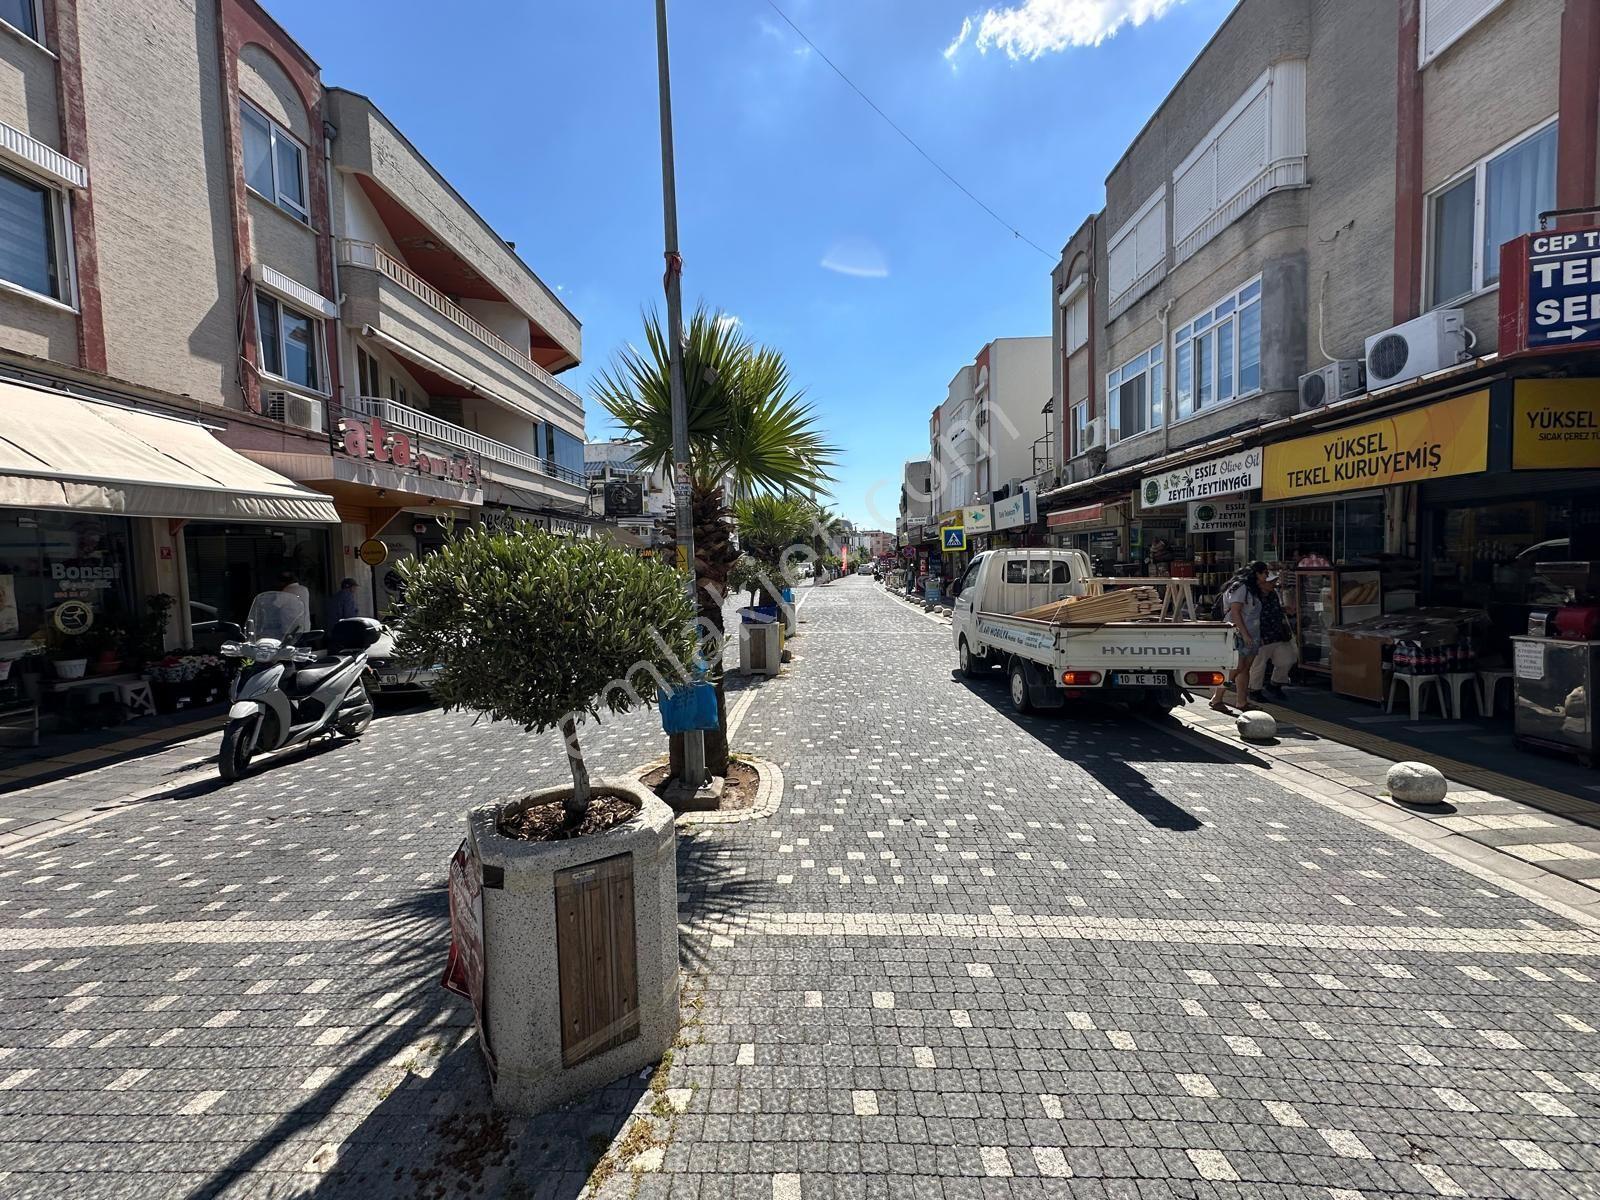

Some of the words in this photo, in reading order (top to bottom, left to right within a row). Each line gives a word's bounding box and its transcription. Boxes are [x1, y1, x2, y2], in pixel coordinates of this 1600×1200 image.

[1533, 234, 1577, 253] CEP
[1584, 231, 1600, 247] T
[1526, 407, 1598, 429] YÜKSEL
[339, 415, 411, 466] ata
[1324, 432, 1388, 462] YÜKSEL
[1538, 432, 1563, 441] SICAK
[1564, 432, 1590, 442] ÇEREZ
[1195, 463, 1217, 481] EŞSİZ
[1220, 460, 1242, 474] Olive
[1244, 453, 1260, 469] Oil
[1287, 467, 1330, 488] TEKEL
[1334, 441, 1442, 482] KURUYEMİŞ
[1168, 484, 1195, 501] ZEYTİN
[1197, 472, 1252, 497] ZEYTİNYAĞI
[1225, 502, 1246, 512] EŞSİZ
[51, 563, 120, 579] Bonsai
[1102, 646, 1190, 655] HYUNDAI
[1120, 674, 1130, 684] 10
[1135, 674, 1145, 684] KE
[1152, 674, 1167, 685] 158
